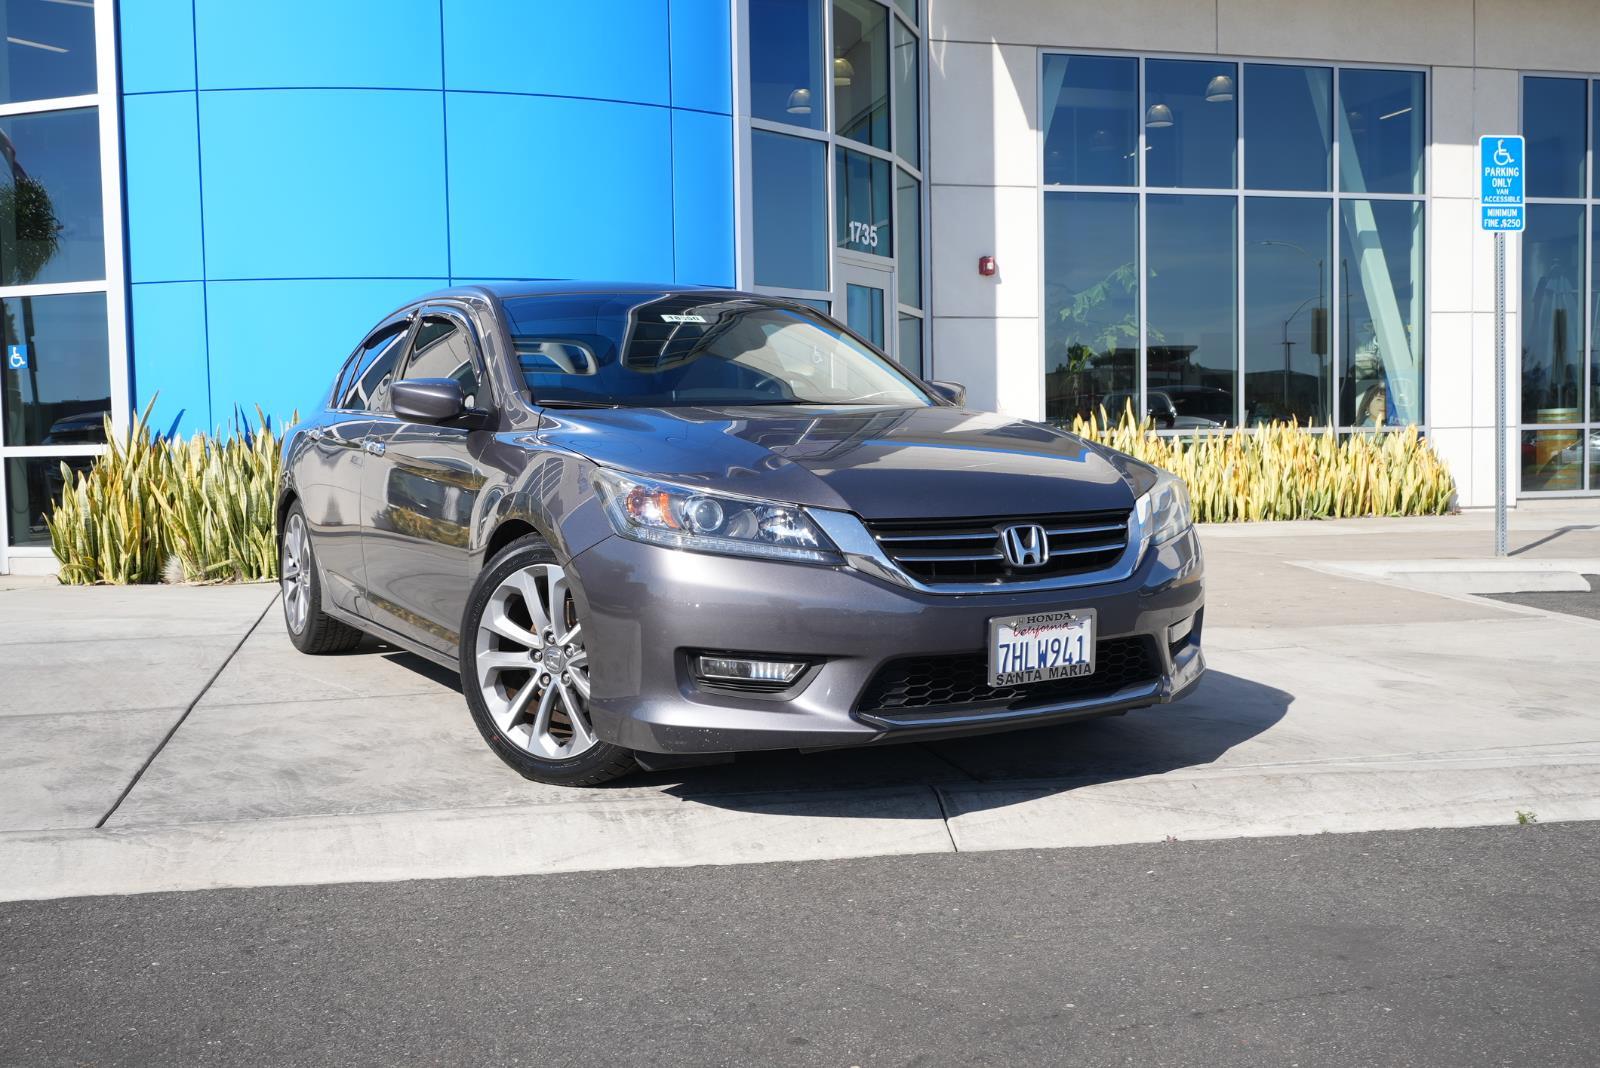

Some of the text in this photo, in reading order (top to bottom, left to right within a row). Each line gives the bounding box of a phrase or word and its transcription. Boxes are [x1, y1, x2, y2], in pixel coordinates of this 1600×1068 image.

[1484, 167, 1520, 177] PARKING
[1492, 178, 1512, 187] ONLY
[1487, 208, 1518, 217] MINIMUM
[1484, 219, 1499, 228] FINE
[849, 221, 878, 247] 1735
[1027, 613, 1072, 624] HONDA
[1013, 622, 1074, 639] California
[999, 635, 1087, 673] 7HLW941
[996, 664, 1092, 686] SANTA MARIA
